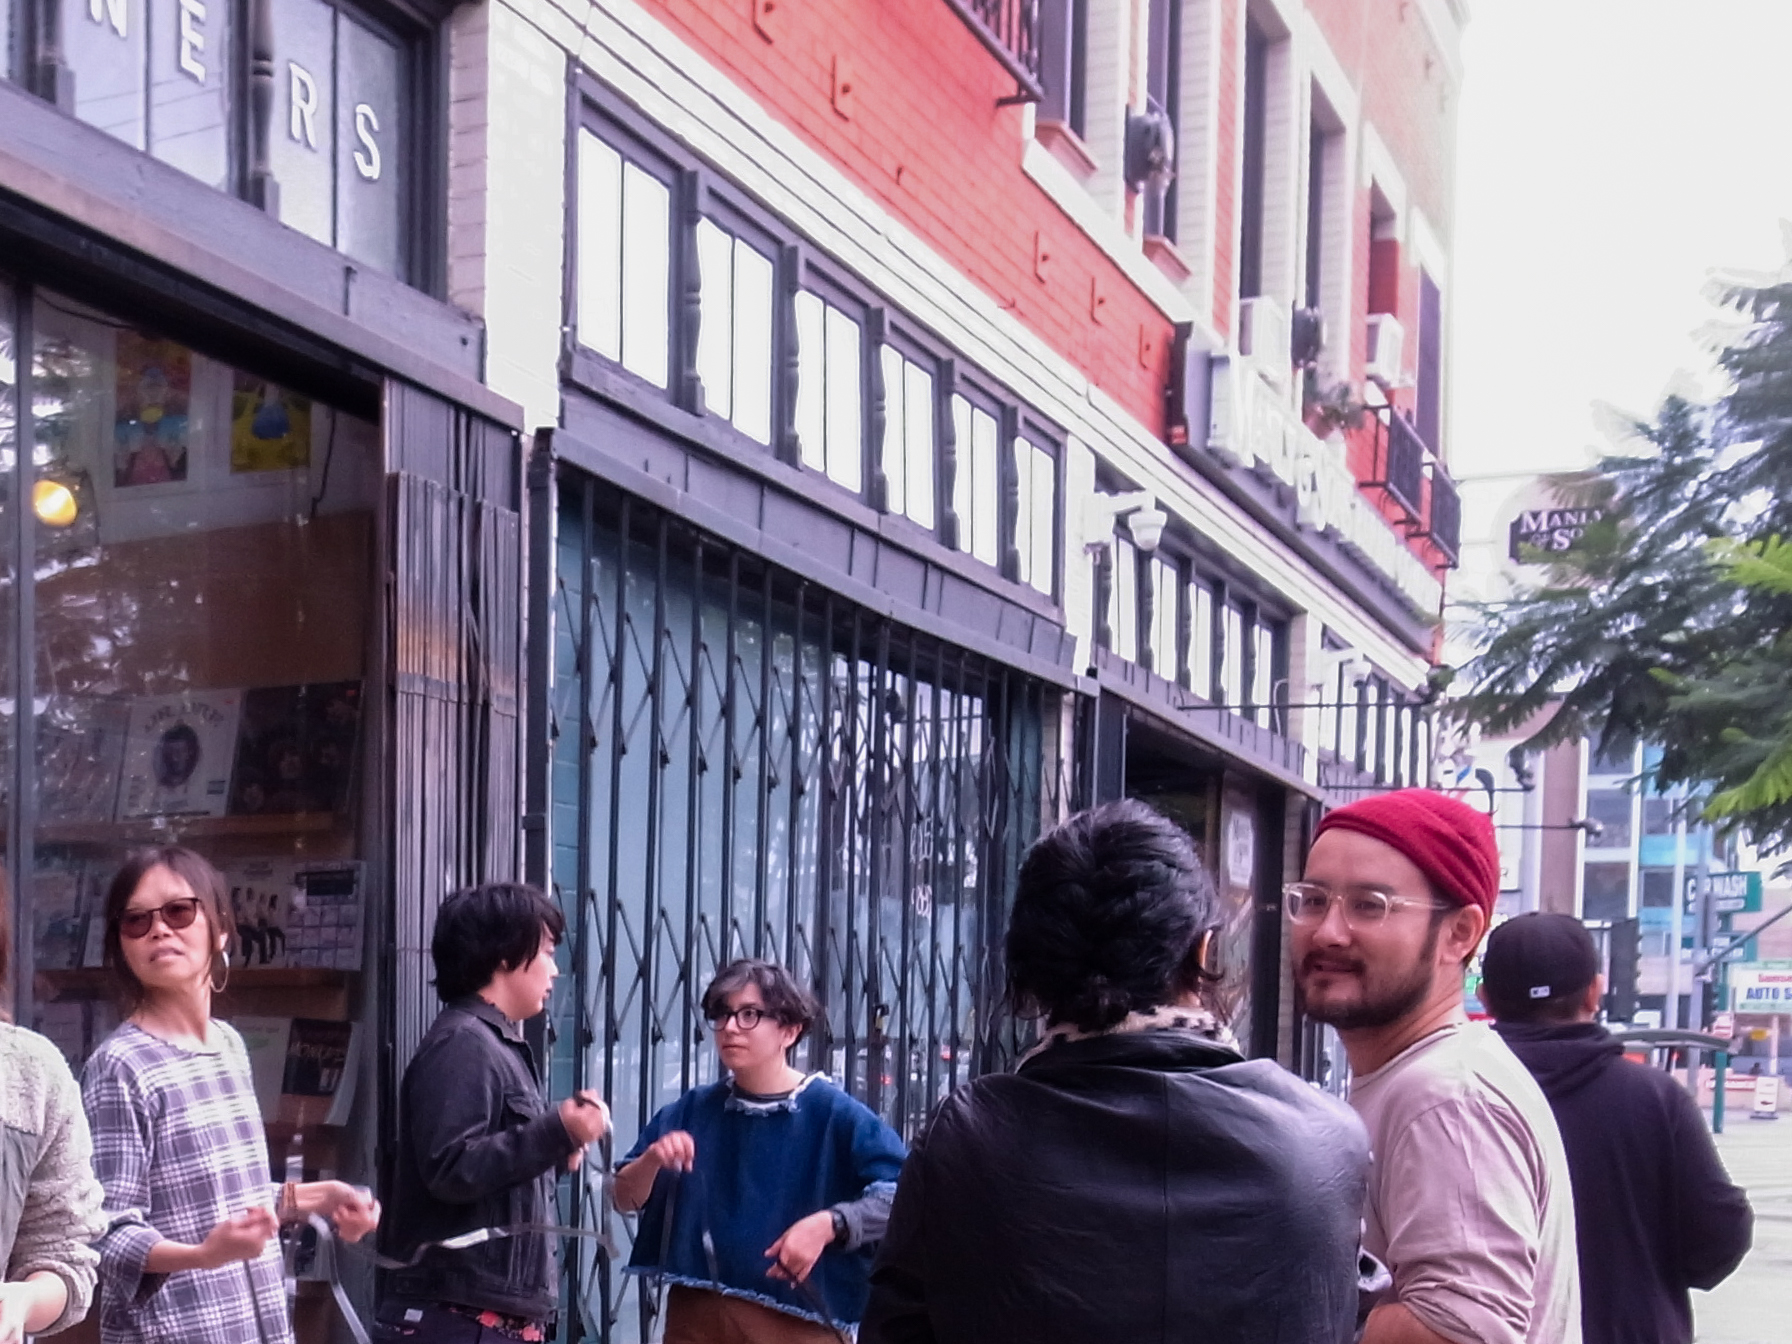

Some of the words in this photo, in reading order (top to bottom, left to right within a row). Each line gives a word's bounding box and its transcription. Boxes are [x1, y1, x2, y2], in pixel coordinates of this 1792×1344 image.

[1687, 877, 1712, 901] CR
[1713, 874, 1747, 897] WASH
[1746, 987, 1780, 1000] AUTO
